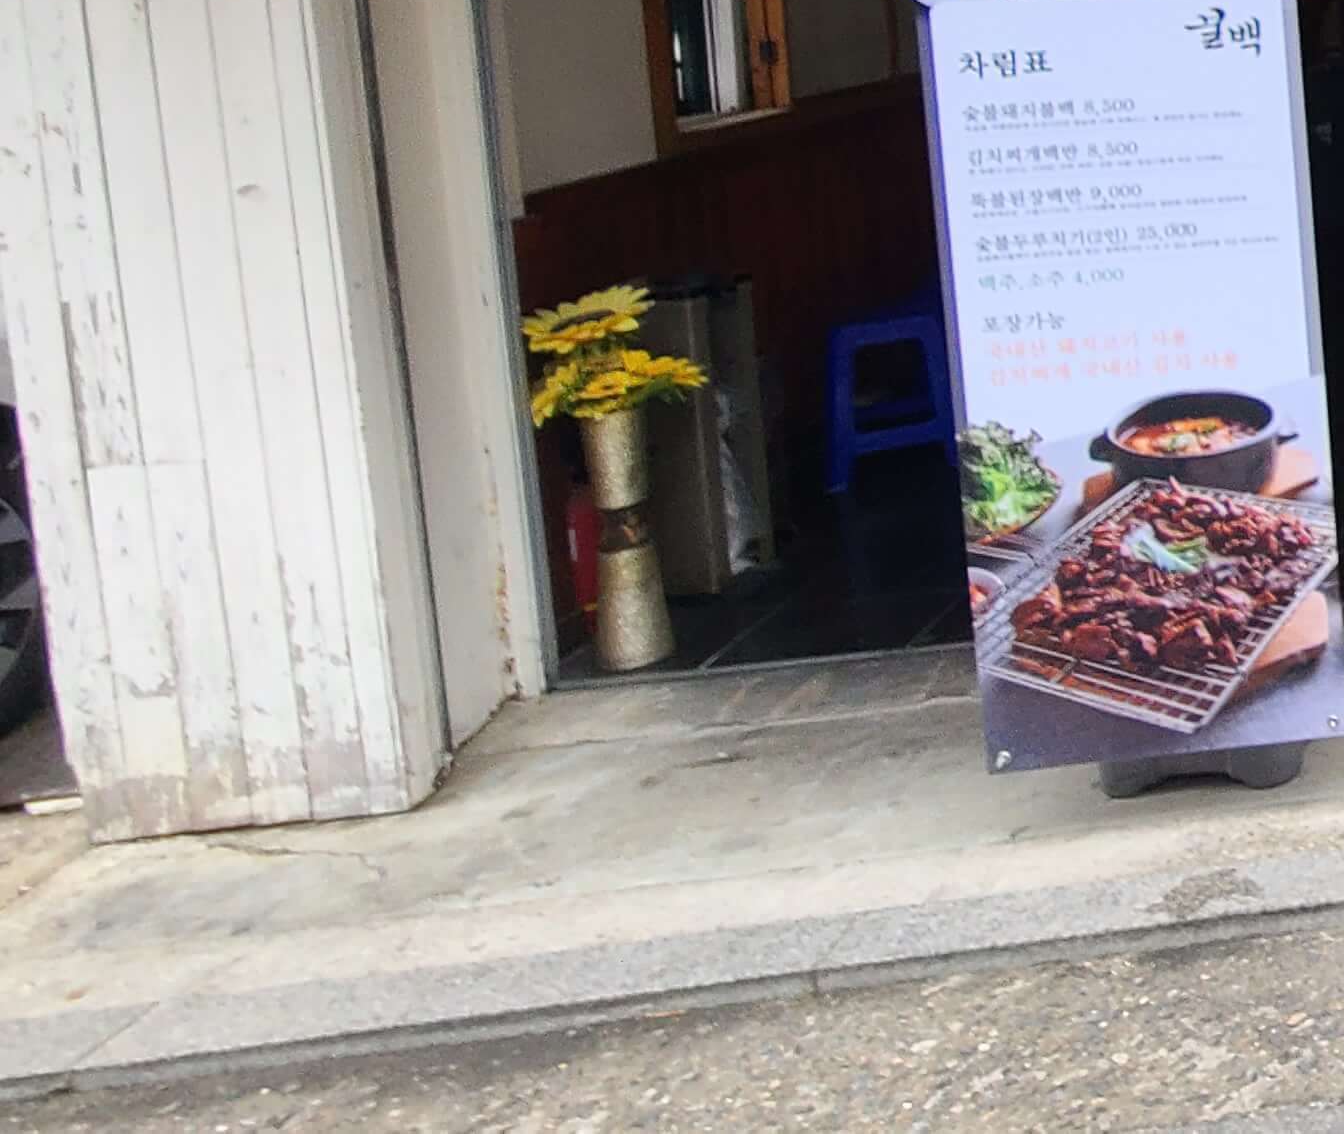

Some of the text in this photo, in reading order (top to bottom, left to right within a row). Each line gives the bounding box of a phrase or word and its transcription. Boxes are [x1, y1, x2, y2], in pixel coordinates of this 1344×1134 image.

[959, 50, 1053, 79] 차림표
[1083, 98, 1136, 117] 8,500
[1087, 141, 1139, 161] 8,500
[1090, 184, 1143, 204] 9,000
